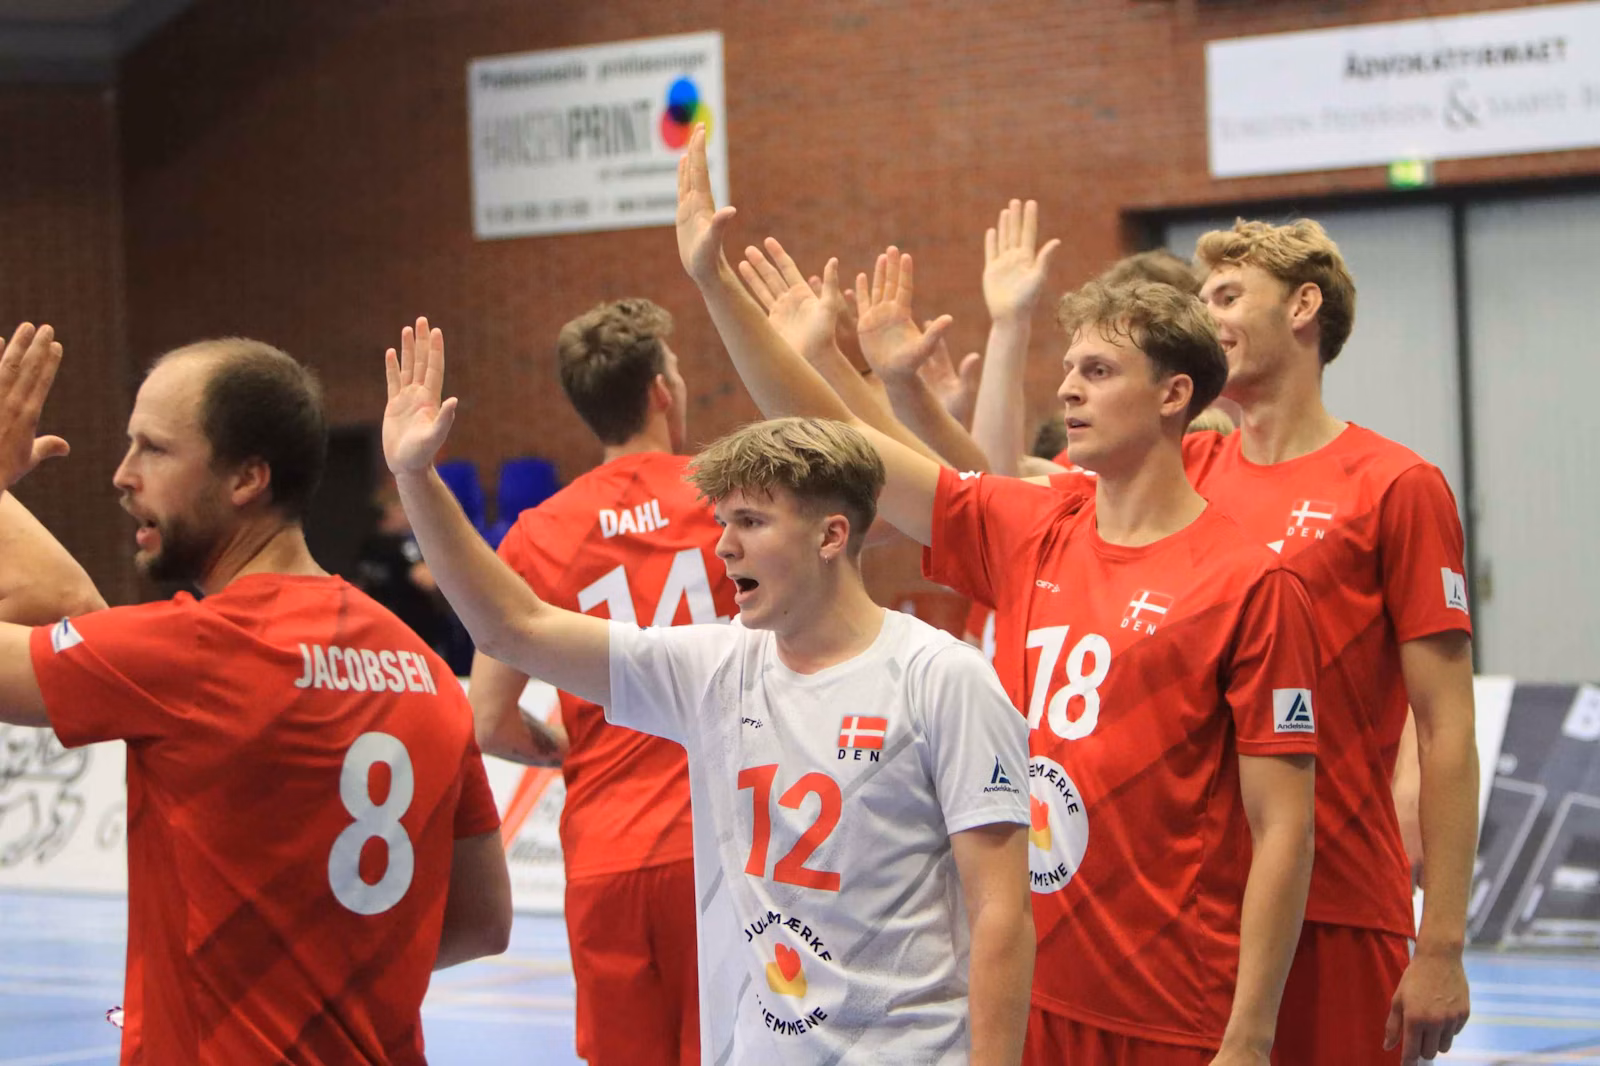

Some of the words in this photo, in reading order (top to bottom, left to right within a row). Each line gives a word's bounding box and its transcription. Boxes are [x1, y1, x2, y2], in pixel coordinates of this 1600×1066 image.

[599, 498, 670, 538] DAHL
[1286, 526, 1325, 540] DEN
[577, 548, 730, 627] 14
[1120, 618, 1157, 635] DEN
[294, 643, 437, 695] JACOBSEN
[1026, 625, 1112, 740] 18
[837, 749, 880, 762] DEN
[328, 732, 414, 915] 8
[737, 764, 843, 892] 12
